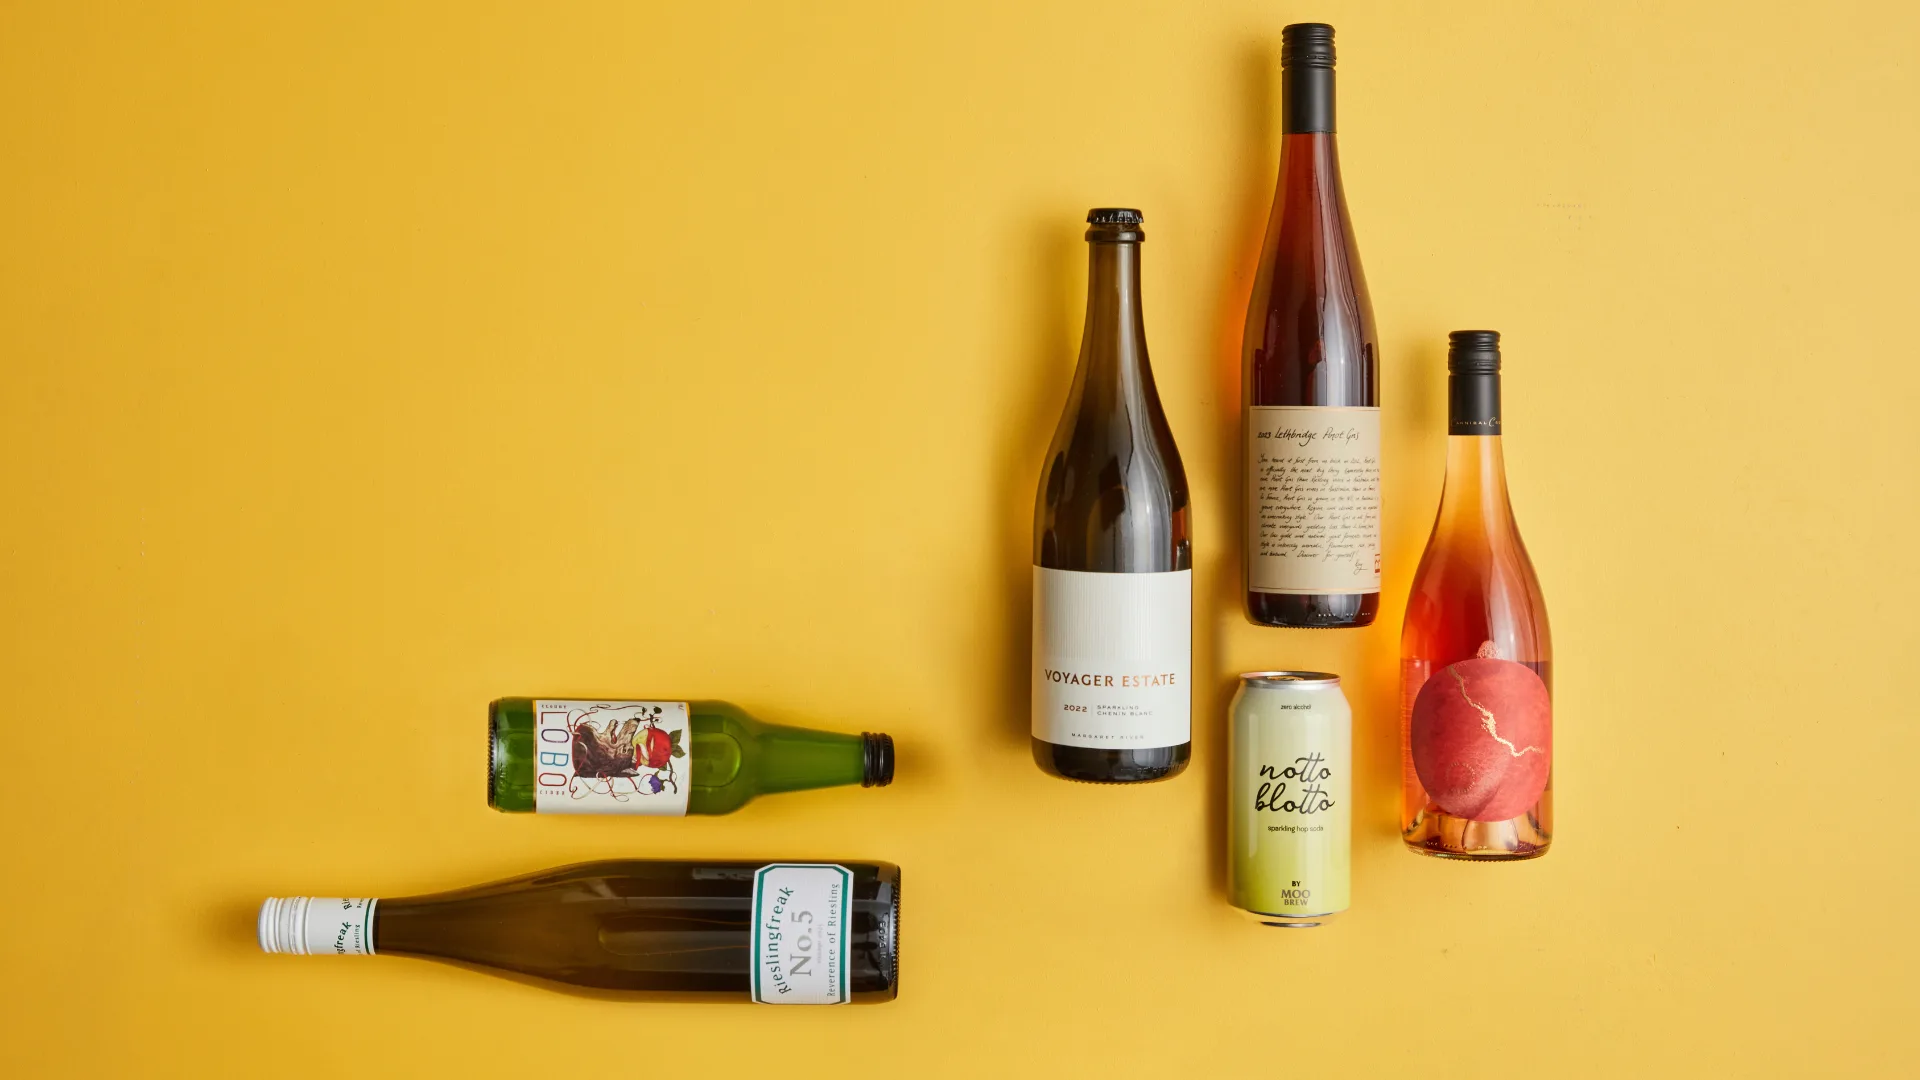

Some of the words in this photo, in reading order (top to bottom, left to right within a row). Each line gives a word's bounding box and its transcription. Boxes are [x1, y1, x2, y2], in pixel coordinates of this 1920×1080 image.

[1275, 426, 1318, 447] Lethbridge
[1045, 669, 1114, 687] VOYAGER
[1122, 673, 1176, 688] ESTATE
[1064, 704, 1088, 713] 2022
[538, 711, 570, 787] LOBO
[1071, 732, 1115, 740] MARGARET
[1259, 752, 1332, 783] notto
[1254, 782, 1336, 815] blotto
[1267, 825, 1296, 833] sparkling
[827, 883, 841, 927] Riesling
[1280, 889, 1311, 899] MOO
[765, 886, 795, 995] Rieslingfreak
[789, 910, 813, 977] No.5
[827, 931, 836, 944] of
[826, 948, 837, 997] Reverence
